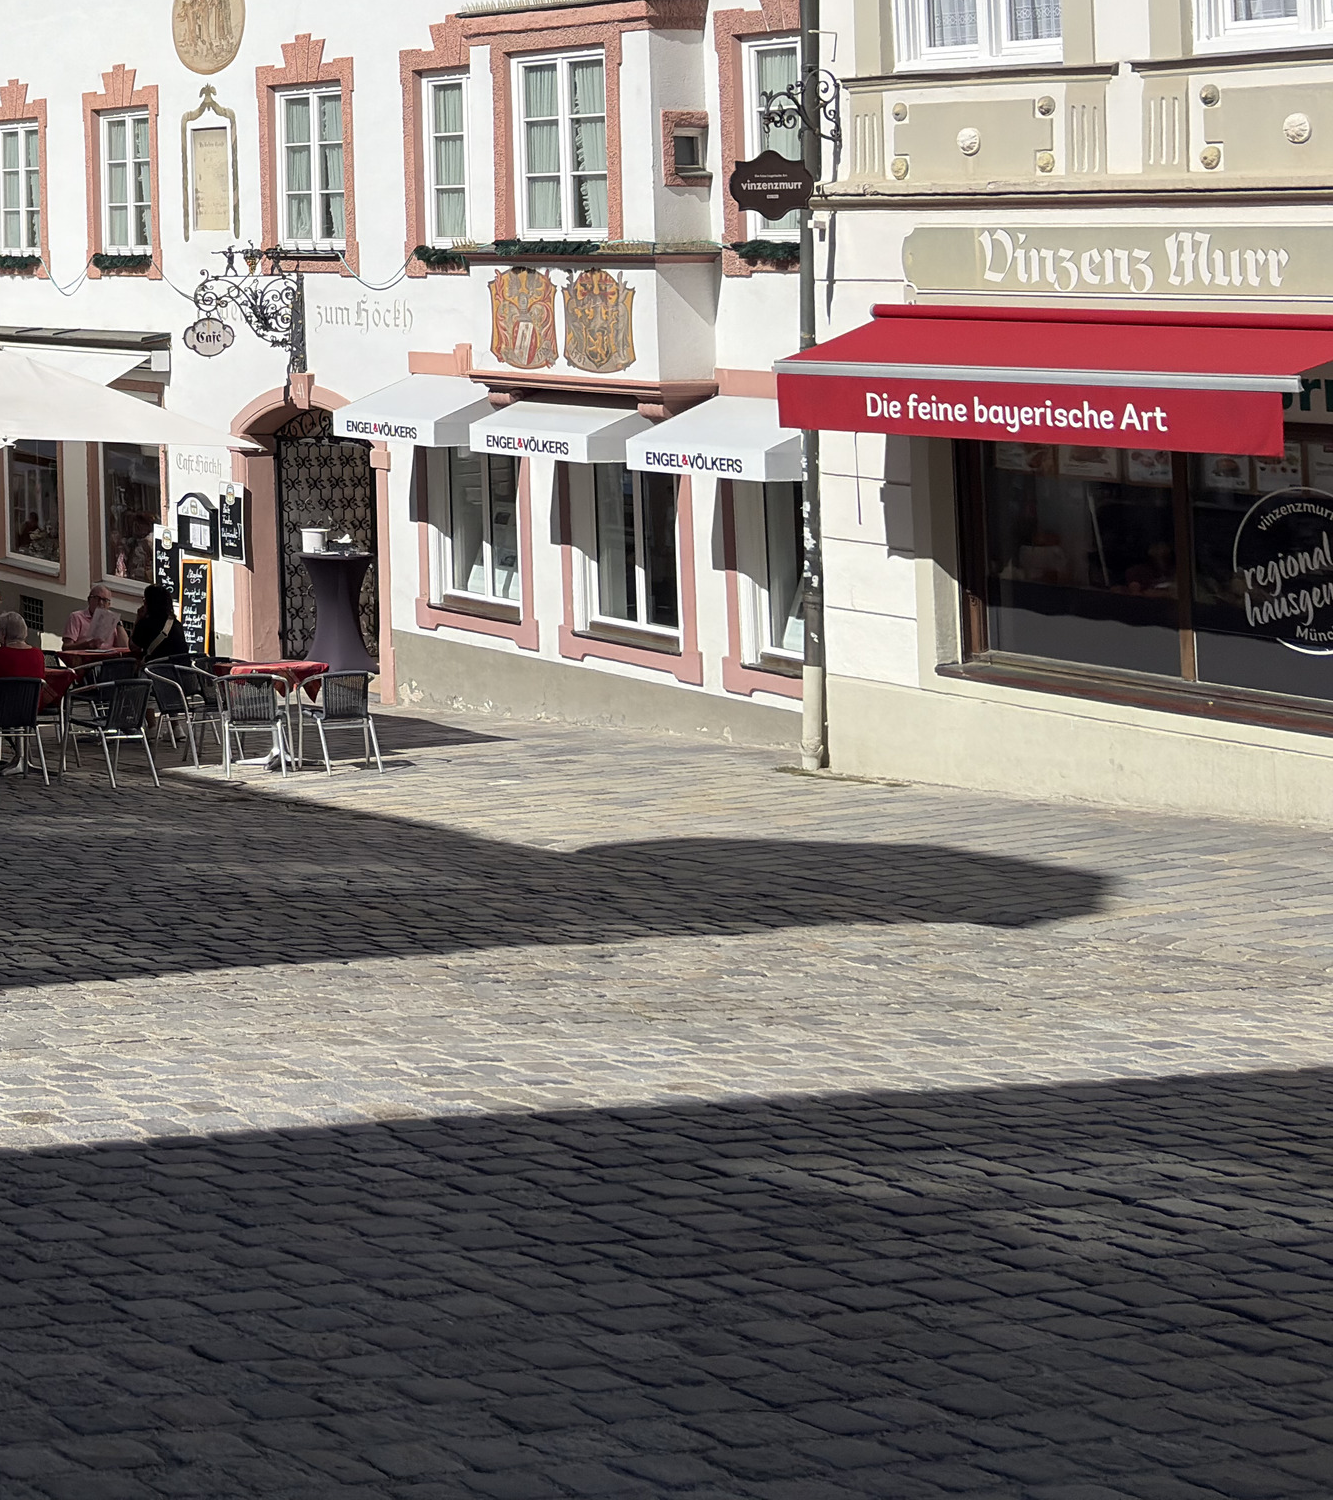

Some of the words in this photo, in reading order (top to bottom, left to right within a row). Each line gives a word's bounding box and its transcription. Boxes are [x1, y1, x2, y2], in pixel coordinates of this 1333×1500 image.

[741, 179, 802, 190] vinzenzmurr
[978, 229, 1154, 292] Vinzenz
[1165, 232, 1290, 287] Murr
[314, 305, 352, 333] zum
[295, 385, 305, 399] 41
[866, 393, 902, 419] Die
[907, 393, 967, 422] feine
[973, 397, 1114, 434] bayerische
[1120, 404, 1168, 432] Art
